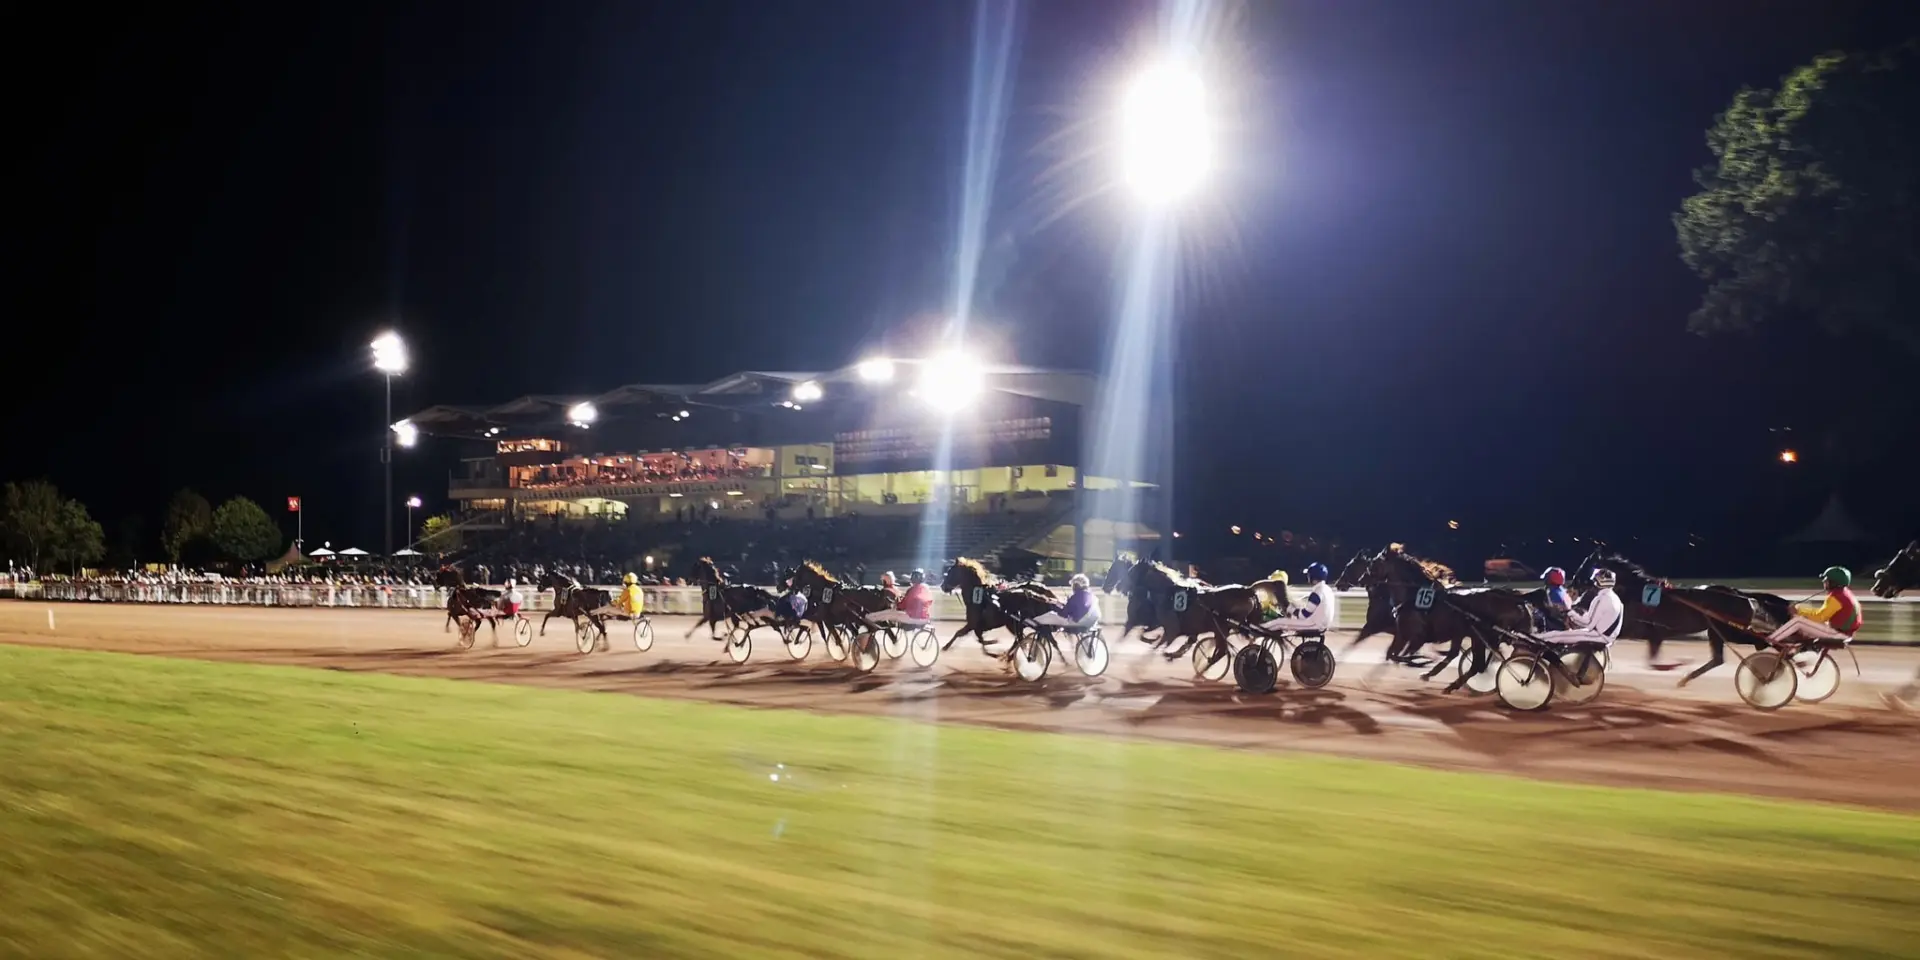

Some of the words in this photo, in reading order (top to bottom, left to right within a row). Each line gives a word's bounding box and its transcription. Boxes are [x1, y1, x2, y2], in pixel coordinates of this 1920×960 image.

[1176, 594, 1185, 608] 3
[1418, 589, 1433, 606] 15
[1645, 587, 1658, 602] 7
